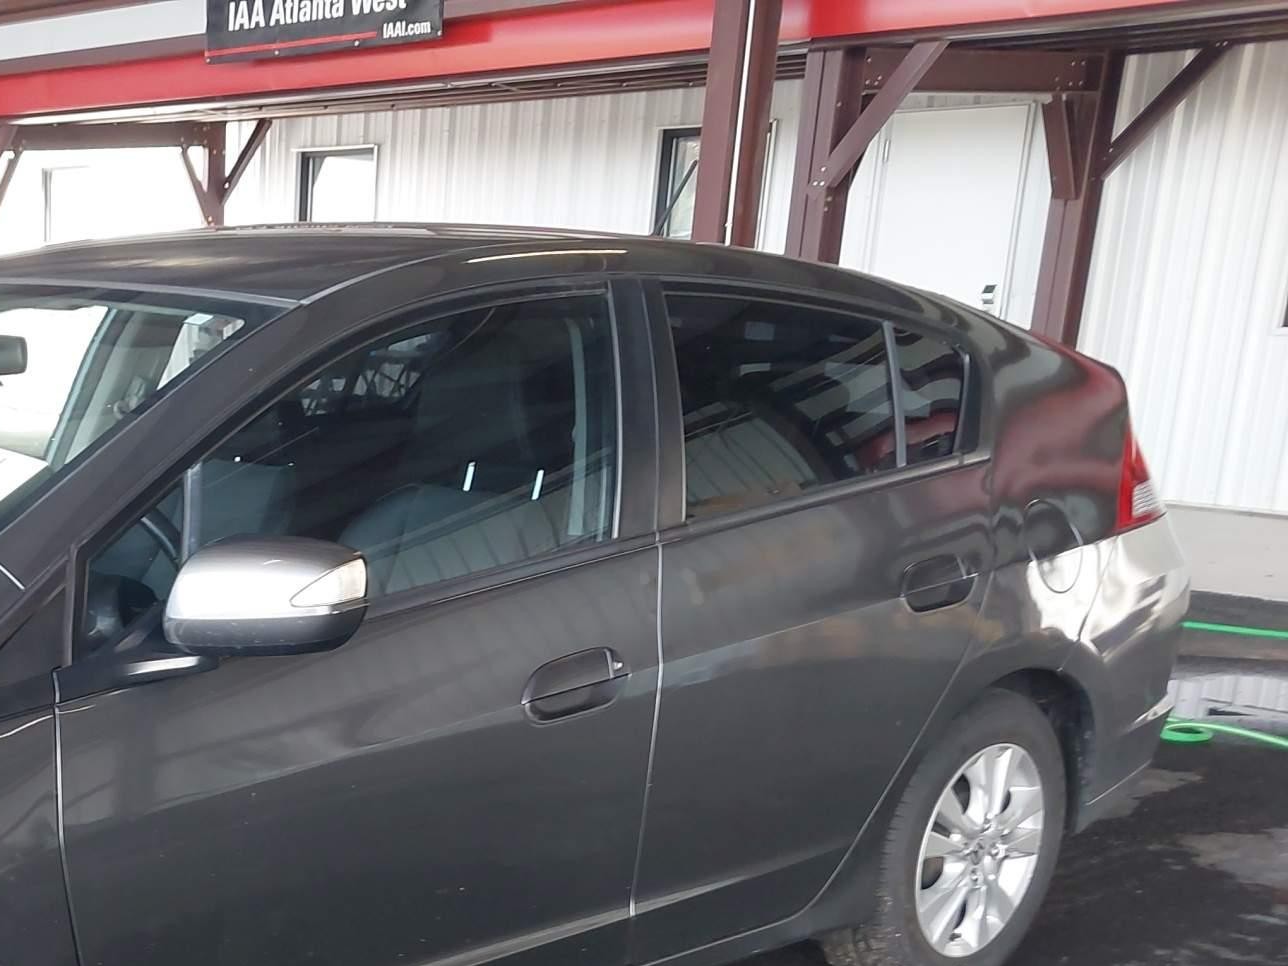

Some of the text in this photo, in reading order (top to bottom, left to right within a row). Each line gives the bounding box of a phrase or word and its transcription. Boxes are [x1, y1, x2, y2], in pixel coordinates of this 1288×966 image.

[228, 0, 266, 32] IAA
[269, 0, 345, 27] Atlanta
[382, 20, 431, 39] IAAI.com
